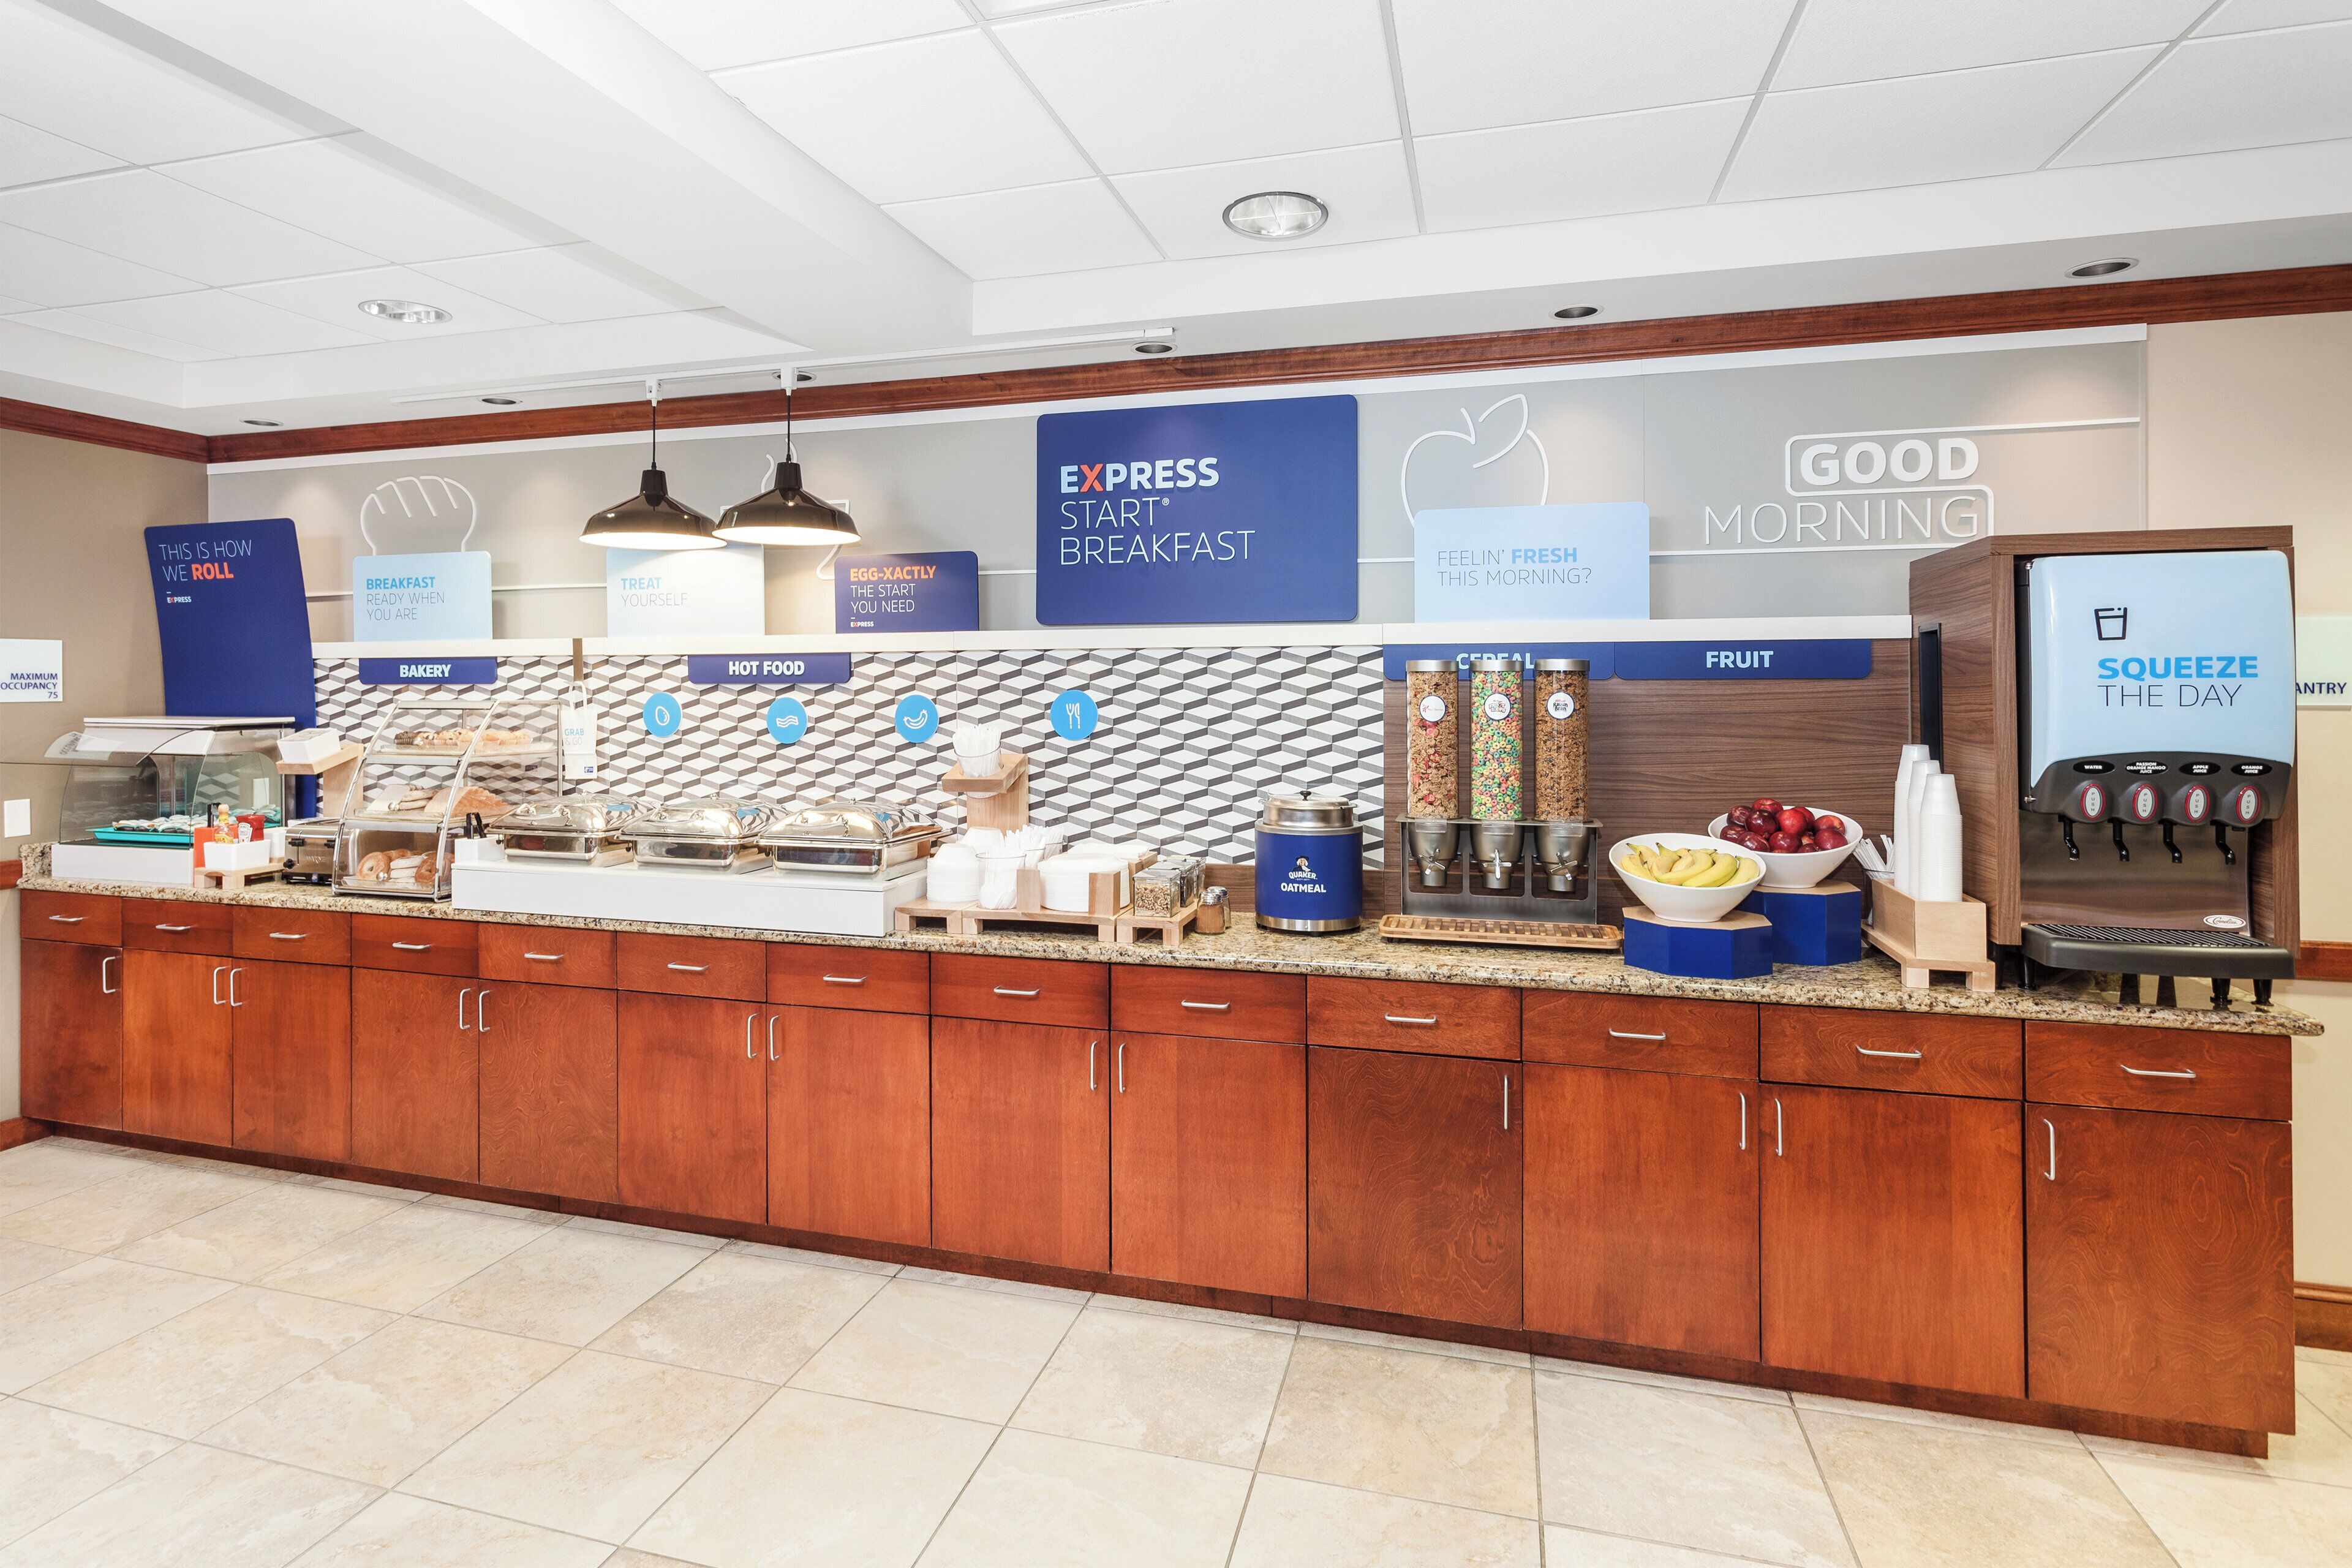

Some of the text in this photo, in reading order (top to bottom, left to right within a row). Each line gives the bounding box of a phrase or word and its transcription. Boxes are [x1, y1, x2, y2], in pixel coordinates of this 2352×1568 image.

[1800, 437, 1979, 486] GOOD
[1060, 457, 1219, 494] EXPRESS
[1705, 496, 1978, 545] MORNING
[159, 539, 252, 560] THIS IS HOW
[1060, 530, 1256, 565] BREAKFAST
[1511, 547, 1577, 564] FRESH
[162, 562, 234, 581] WE ROLL
[850, 565, 937, 581] EGG-XACTLY
[1438, 567, 1592, 586] THIS MORNING?
[366, 576, 435, 590] BREAKFAST
[620, 577, 662, 590] TREAT
[850, 584, 916, 597] THE START
[367, 592, 445, 605] READY WHEN
[621, 592, 687, 606] YOURSELF
[851, 600, 915, 613] YOU NEED
[367, 608, 418, 620] YOU ARE
[1706, 650, 1774, 668] FRUIT
[399, 664, 451, 677] BAKERY
[728, 660, 805, 676] HOT FOOD
[2098, 656, 2258, 682] SQUEEZE
[2097, 684, 2242, 706] THE DAY
[1288, 871, 1317, 880] QUAKER
[1281, 882, 1326, 893] OATMEAL
